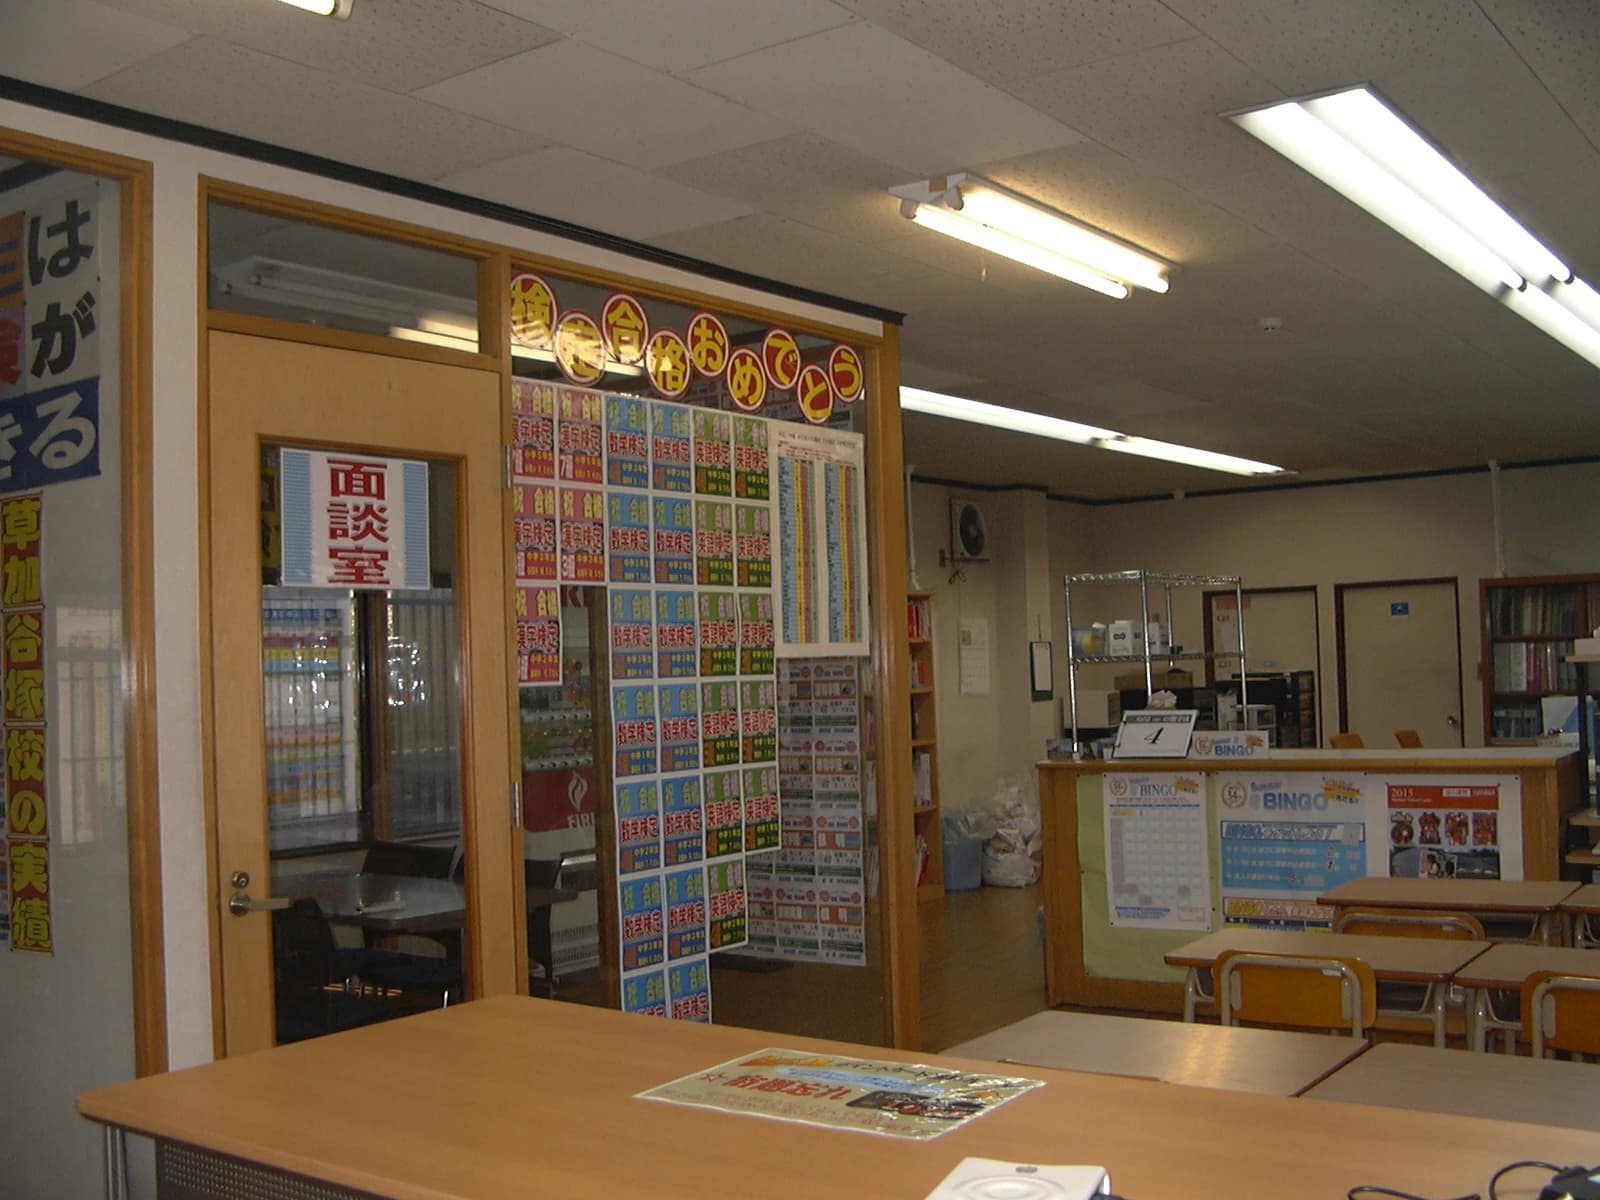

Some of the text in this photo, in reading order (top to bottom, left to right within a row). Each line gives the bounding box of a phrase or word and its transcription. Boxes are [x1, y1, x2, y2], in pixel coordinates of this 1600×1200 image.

[513, 279, 860, 419] 検定合格おめでとう
[328, 459, 390, 584] 面談室
[2, 499, 52, 949] 草加谷塚校の実績
[1215, 744, 1254, 757] BINGO
[1140, 784, 1177, 797] BINGO
[1263, 792, 1329, 811] BINGO
